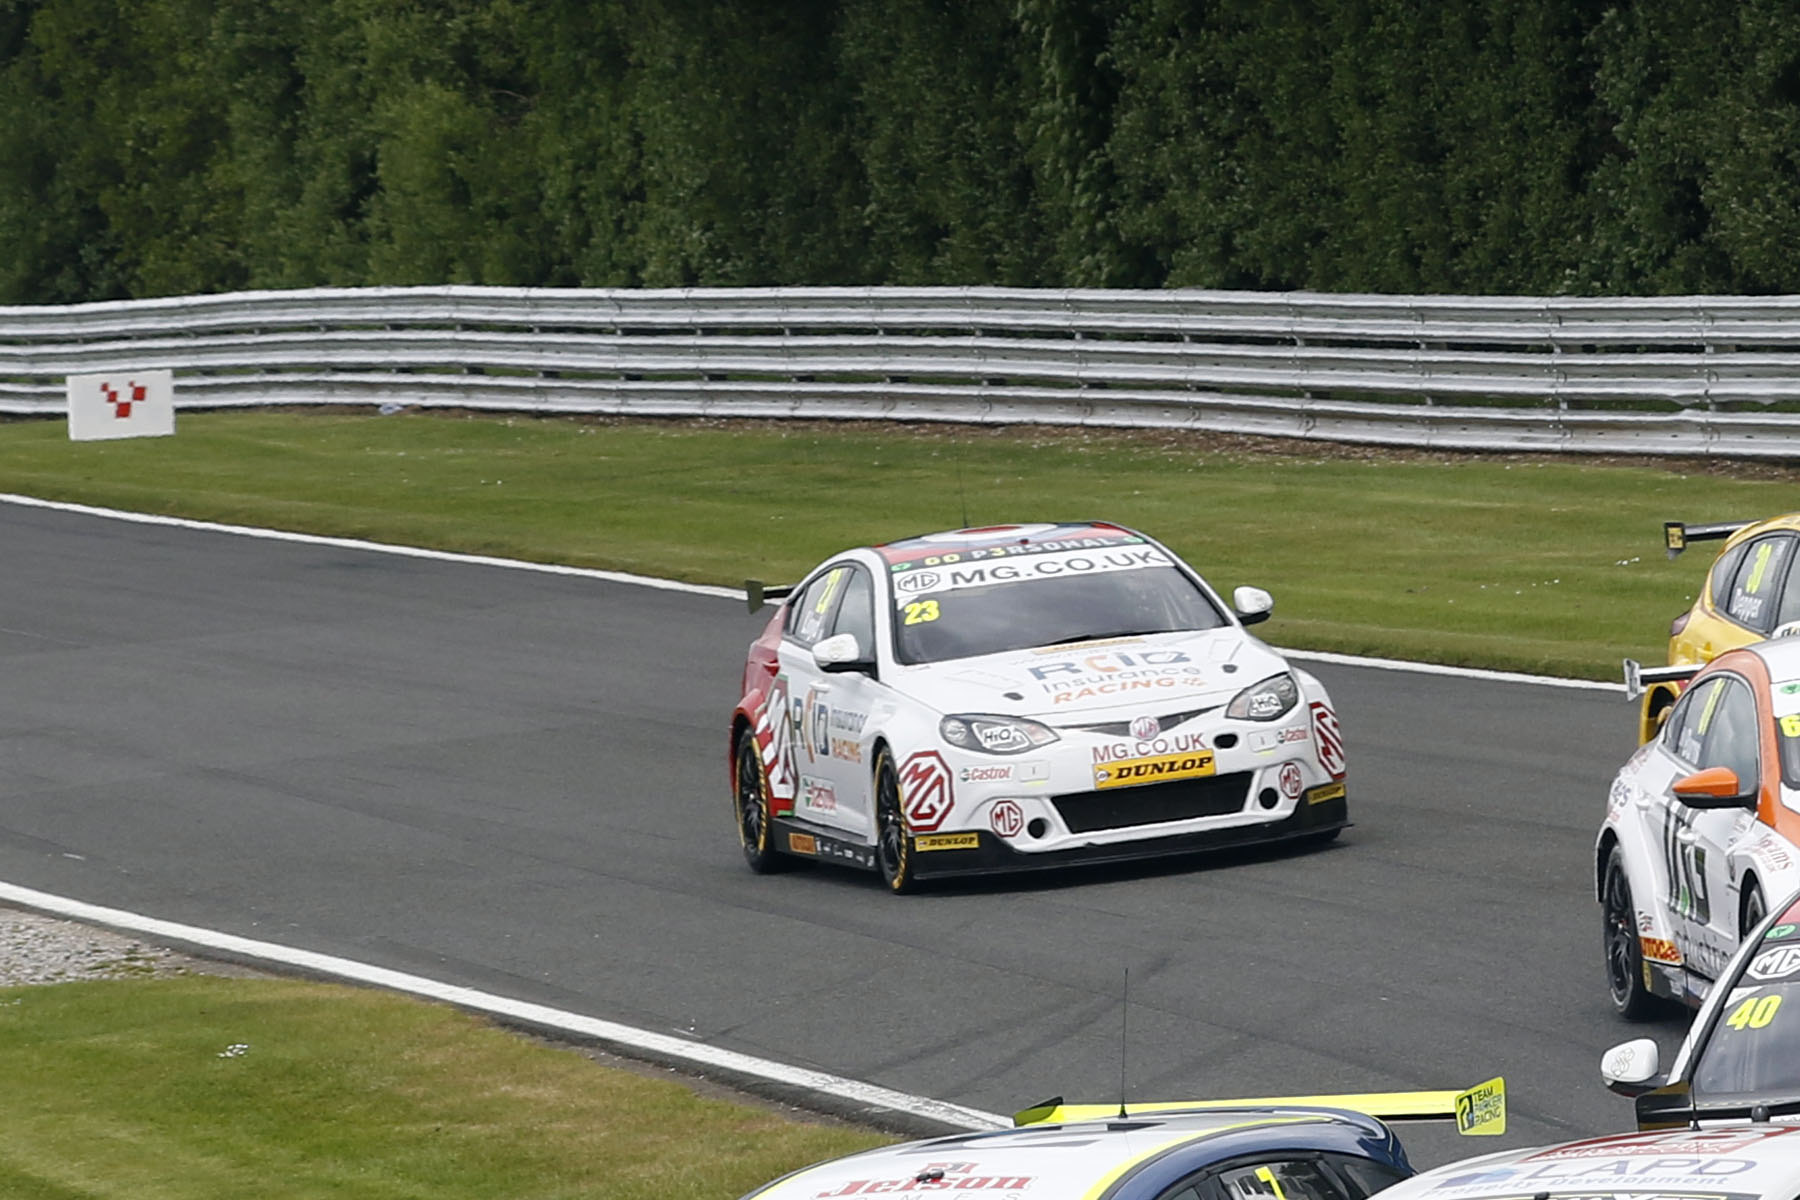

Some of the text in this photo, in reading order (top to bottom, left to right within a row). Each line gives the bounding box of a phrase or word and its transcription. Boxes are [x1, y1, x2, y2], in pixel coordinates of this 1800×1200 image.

[949, 550, 1169, 585] MG.CO.UK
[904, 600, 939, 625] 23
[1054, 677, 1176, 704] RACING
[1092, 732, 1207, 763] MG.CO.UK
[968, 766, 1011, 782] Castrol
[1114, 755, 1213, 781] DUNLOP
[901, 758, 950, 825] MG
[993, 804, 1021, 834] MG
[928, 836, 976, 848] DUNLOP
[1726, 994, 1782, 1031] 40
[1472, 1086, 1493, 1102] TEAM
[1523, 1159, 1757, 1180] LAPD
